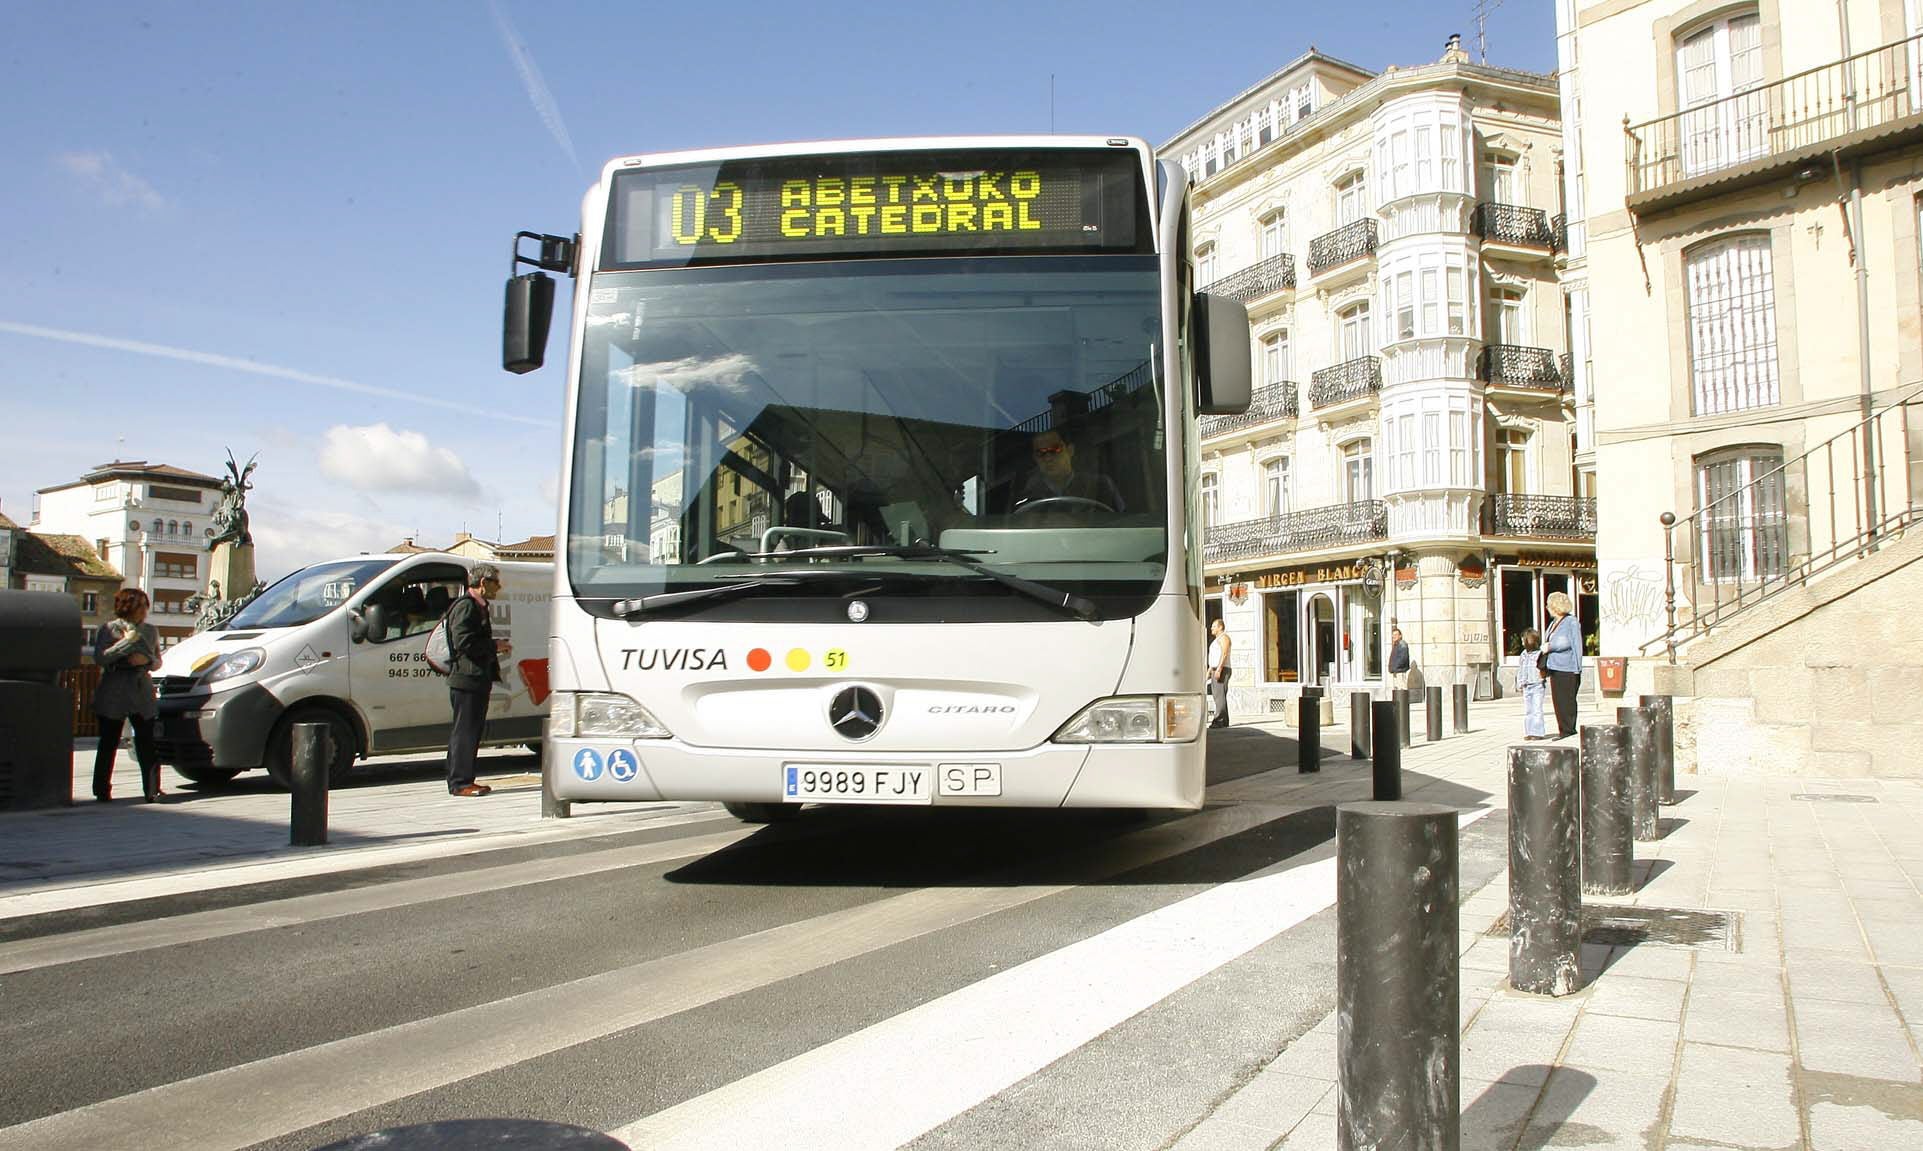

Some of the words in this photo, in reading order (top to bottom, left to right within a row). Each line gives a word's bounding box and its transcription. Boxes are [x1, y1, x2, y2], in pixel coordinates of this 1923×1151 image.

[781, 170, 1041, 207] ABETXUKO
[671, 182, 743, 244] 03
[781, 201, 1041, 237] CATEDRAL
[1259, 571, 1306, 588] VIRGEN
[389, 652, 410, 662] 667
[620, 648, 728, 671] TUVISA
[825, 652, 845, 667] 51
[388, 668, 409, 678] 945
[412, 668, 433, 678] 307
[928, 705, 1016, 714] CITARO
[803, 771, 865, 793] 9989
[875, 772, 922, 794] FJY
